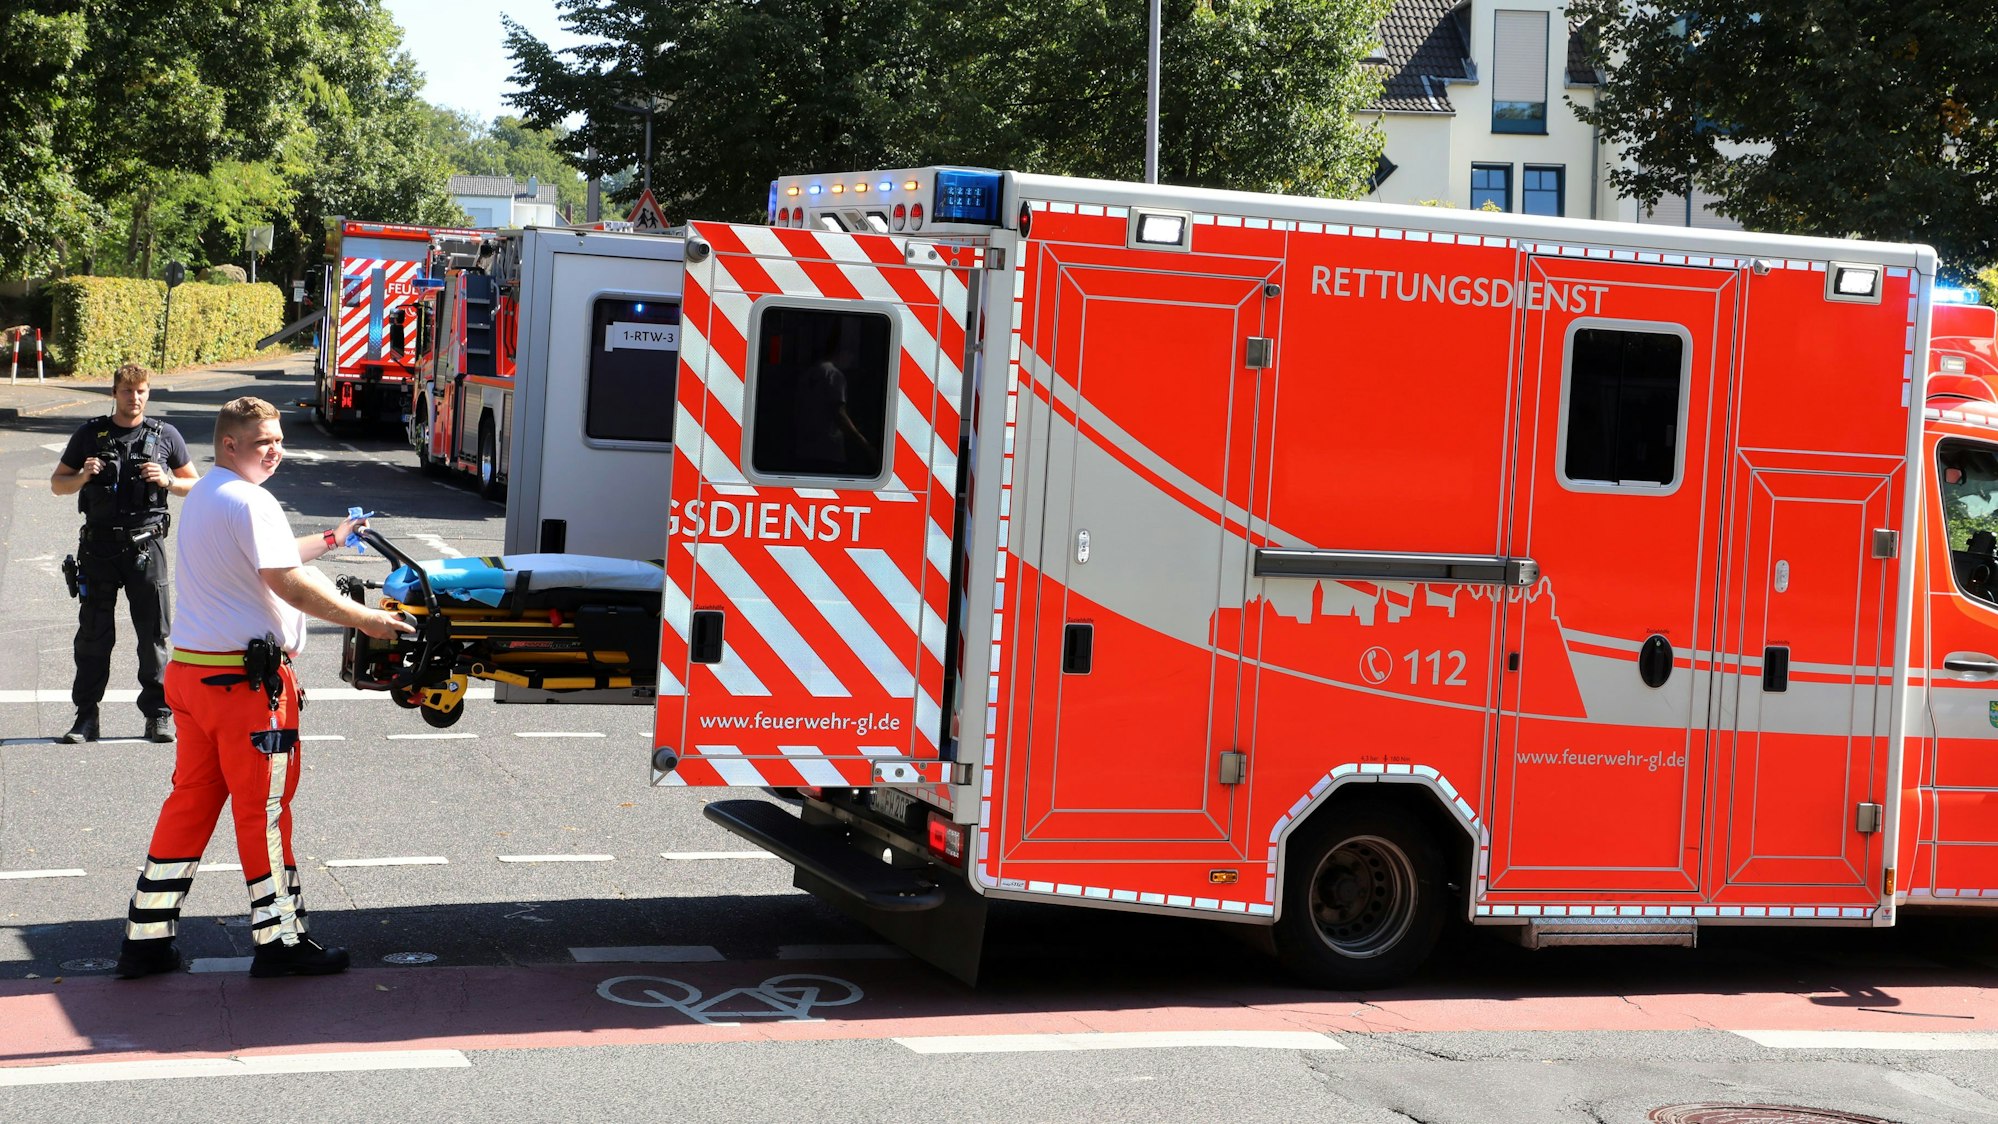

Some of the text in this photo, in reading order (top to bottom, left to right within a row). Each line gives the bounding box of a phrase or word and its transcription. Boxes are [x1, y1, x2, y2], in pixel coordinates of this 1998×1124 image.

[1312, 265, 1609, 314] RETTUNGSDIENST
[624, 331, 674, 343] 1-RTW-3
[1403, 649, 1467, 686] 112
[700, 711, 900, 736] www.feuerwehr-gl.de
[1516, 748, 1685, 772] www.feuerwehr-gl.de
